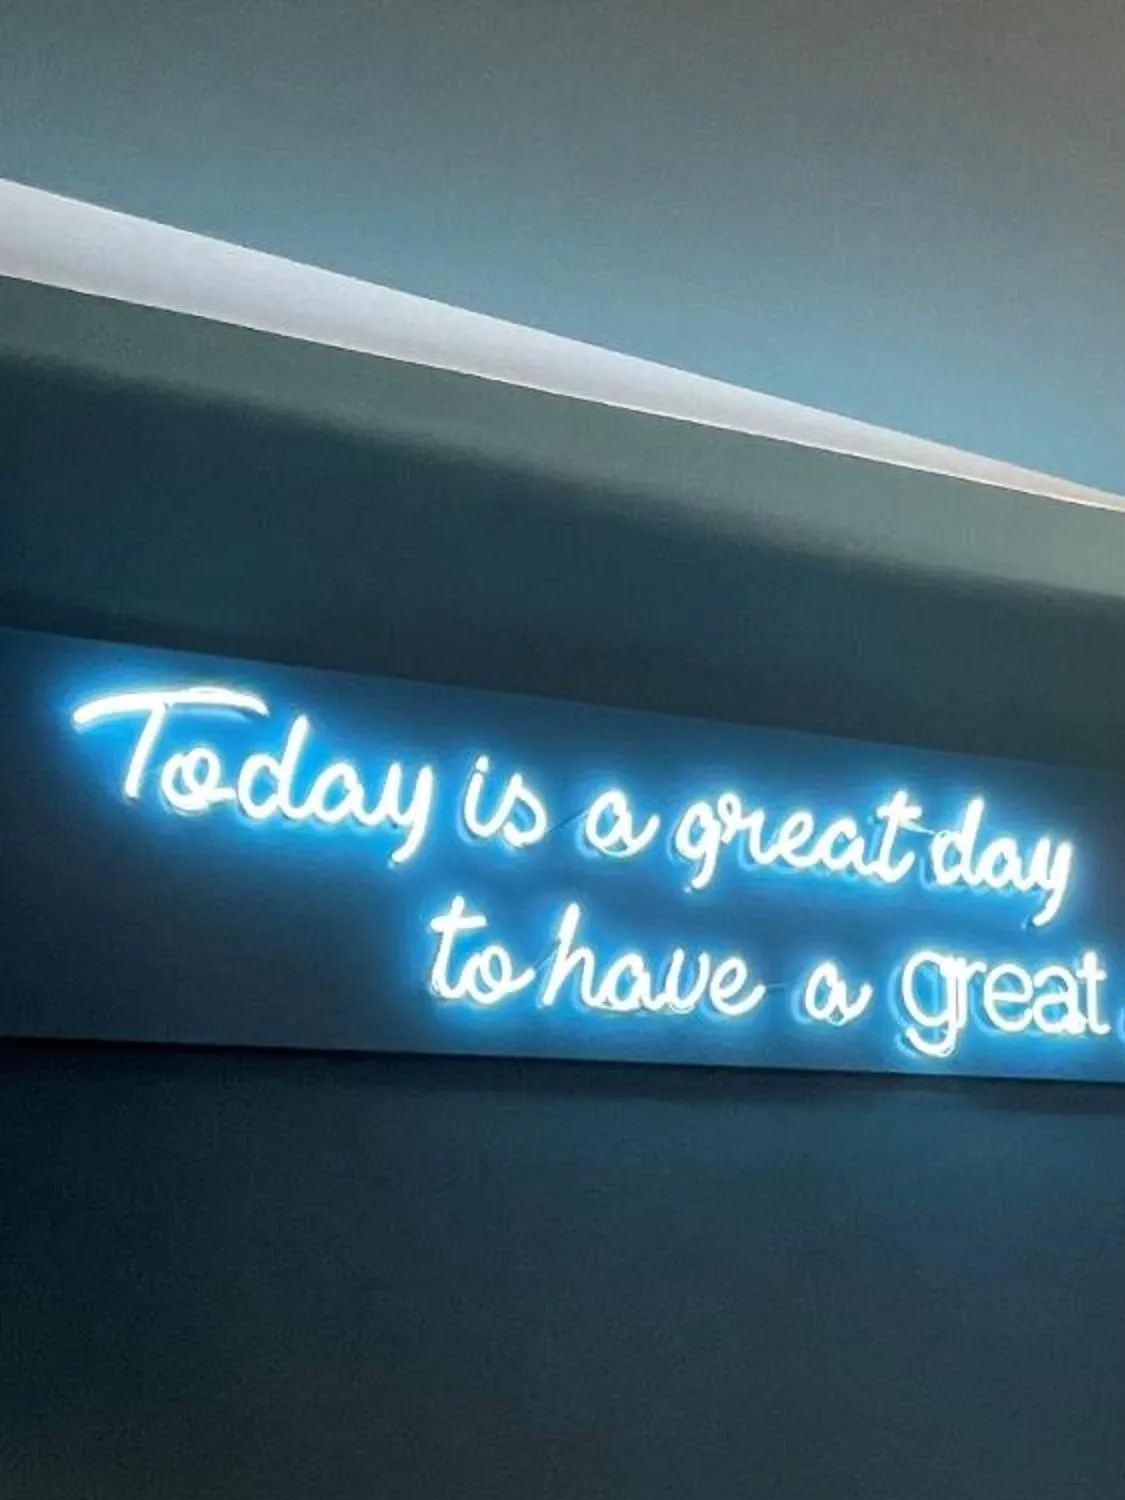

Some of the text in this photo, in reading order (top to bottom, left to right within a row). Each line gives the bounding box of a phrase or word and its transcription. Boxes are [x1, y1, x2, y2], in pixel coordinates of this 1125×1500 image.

[71, 684, 1075, 928] Today is a great day
[429, 893, 537, 1006] to
[540, 901, 766, 1016] have
[803, 961, 872, 1024] a
[899, 948, 1110, 1060] great
